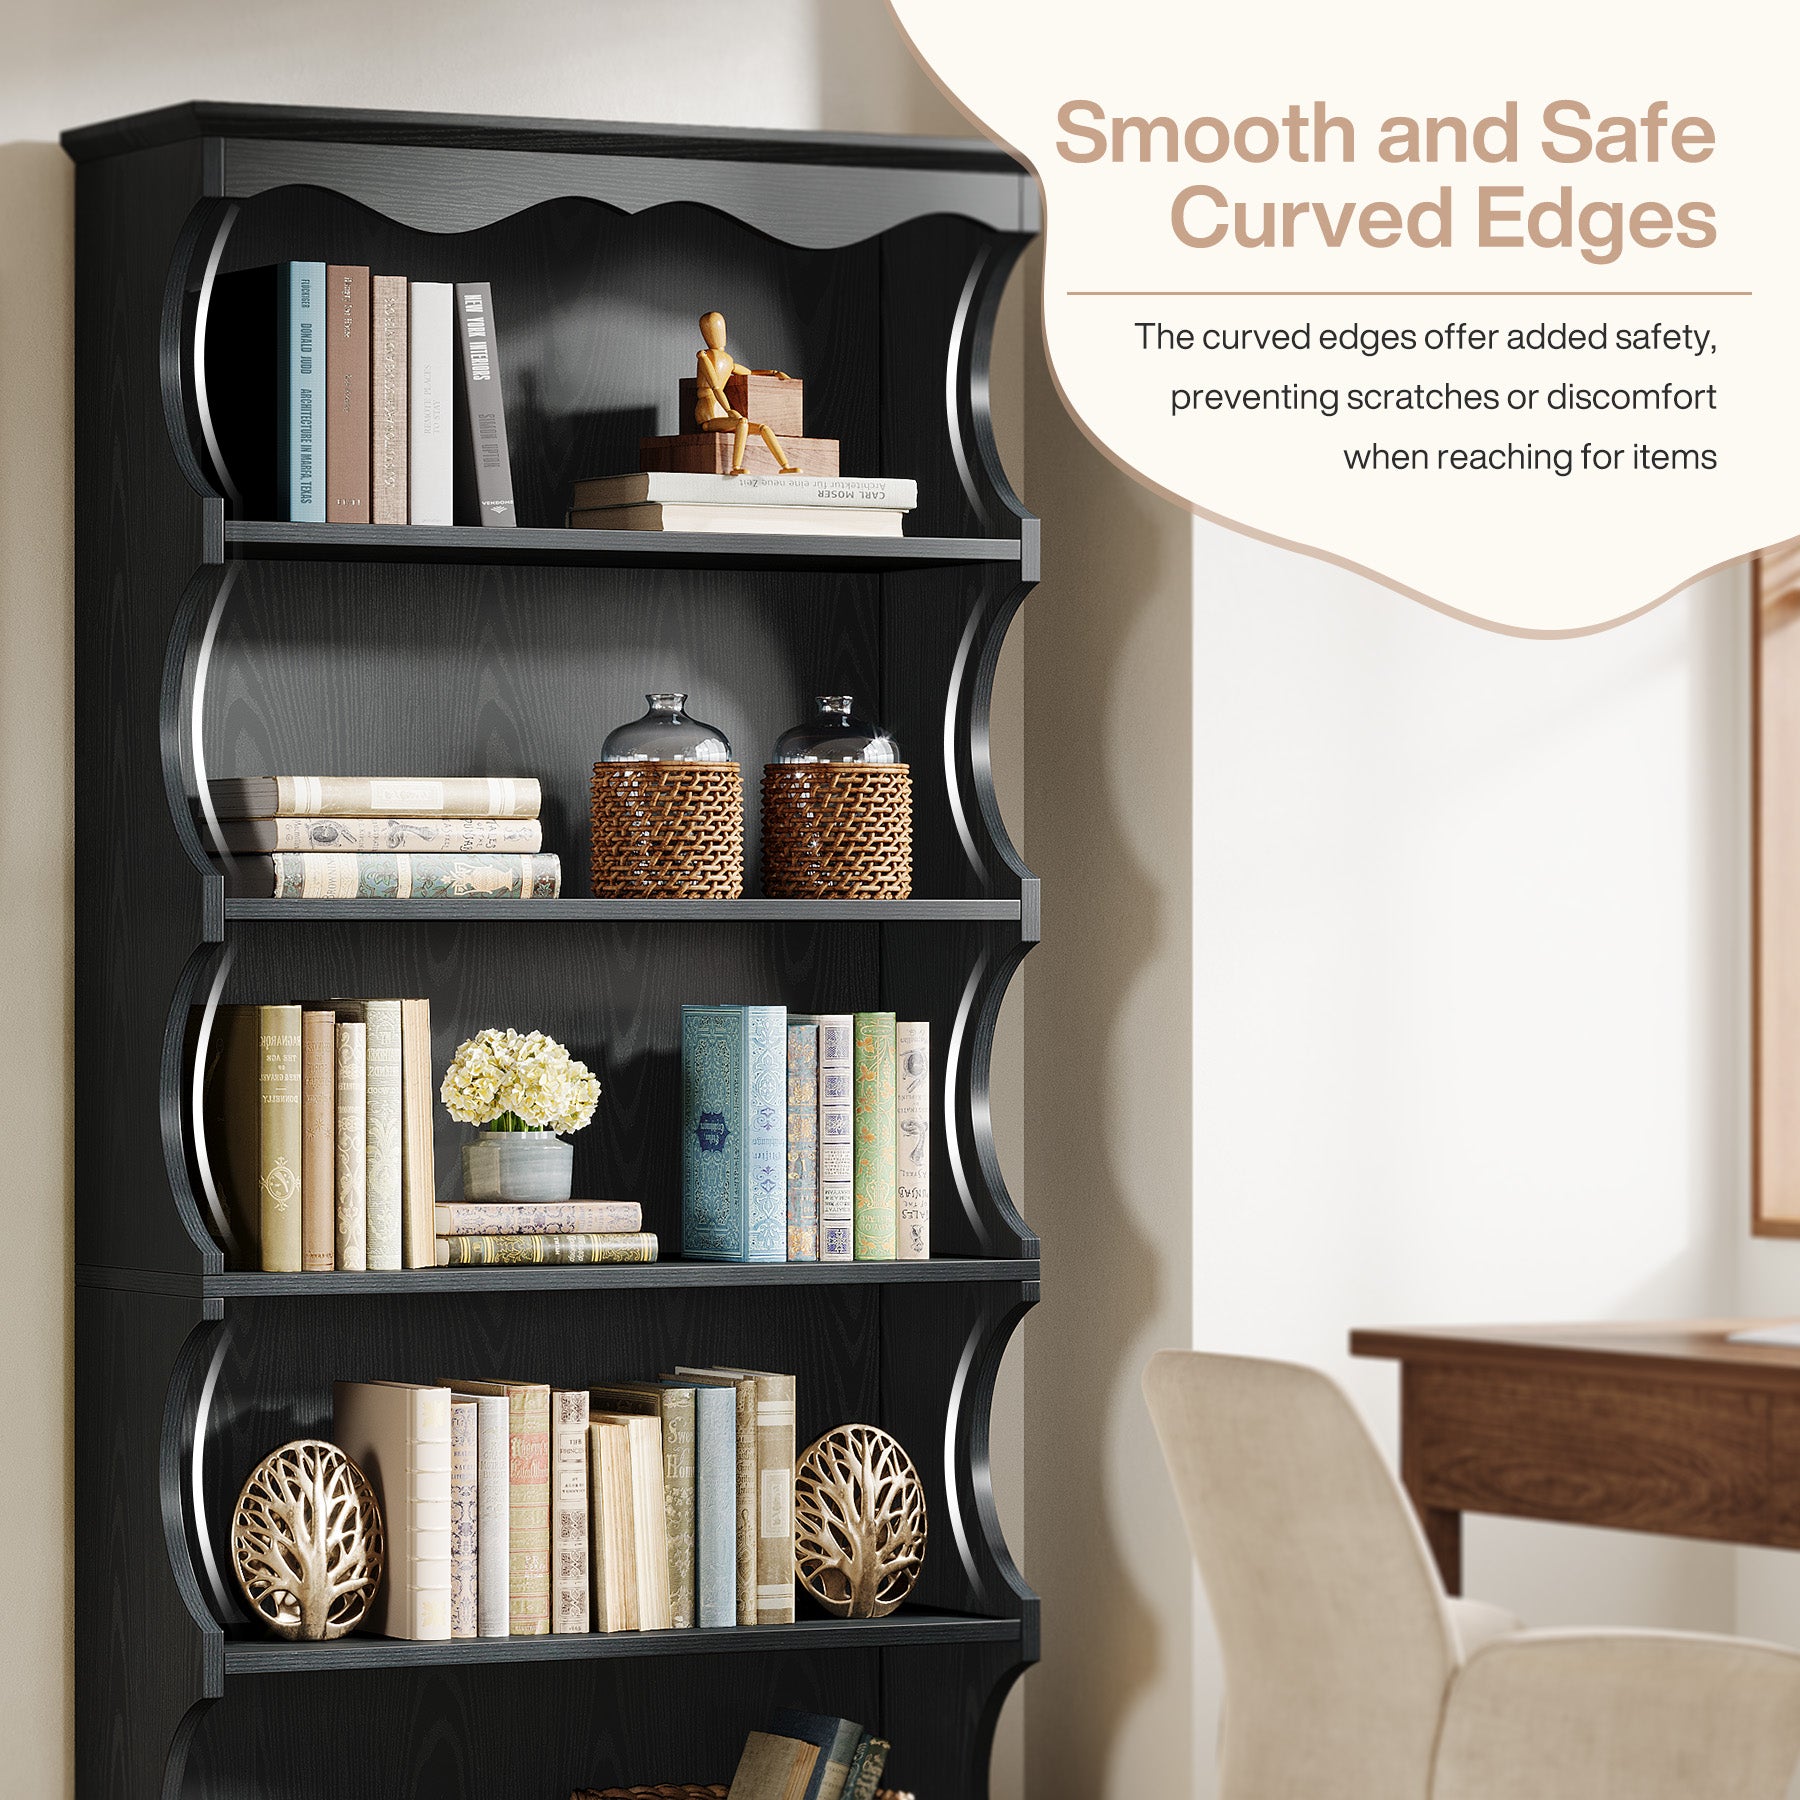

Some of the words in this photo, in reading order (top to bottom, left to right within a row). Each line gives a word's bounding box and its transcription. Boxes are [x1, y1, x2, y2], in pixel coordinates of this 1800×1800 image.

[464, 294, 484, 313] NEW
[301, 323, 312, 352] DONALD
[466, 317, 487, 338] YORK
[301, 355, 312, 375] JUDD
[469, 341, 491, 381] INTERIORS
[300, 388, 312, 443] ARCHITECTURE
[423, 398, 432, 435] REMOTE
[432, 399, 441, 421] STAY
[478, 413, 497, 440] SIMON
[300, 444, 312, 453] IN
[481, 444, 501, 469] UPTON
[300, 453, 312, 480] MARFA,
[300, 481, 312, 504] TEXAS
[739, 479, 759, 487] Zeit
[760, 479, 786, 488] neue
[788, 480, 811, 488] eine
[811, 481, 827, 490] für
[830, 481, 886, 491] Architektur
[817, 490, 855, 499] MOSER
[859, 490, 886, 500] CARL
[485, 819, 500, 849] TALES
